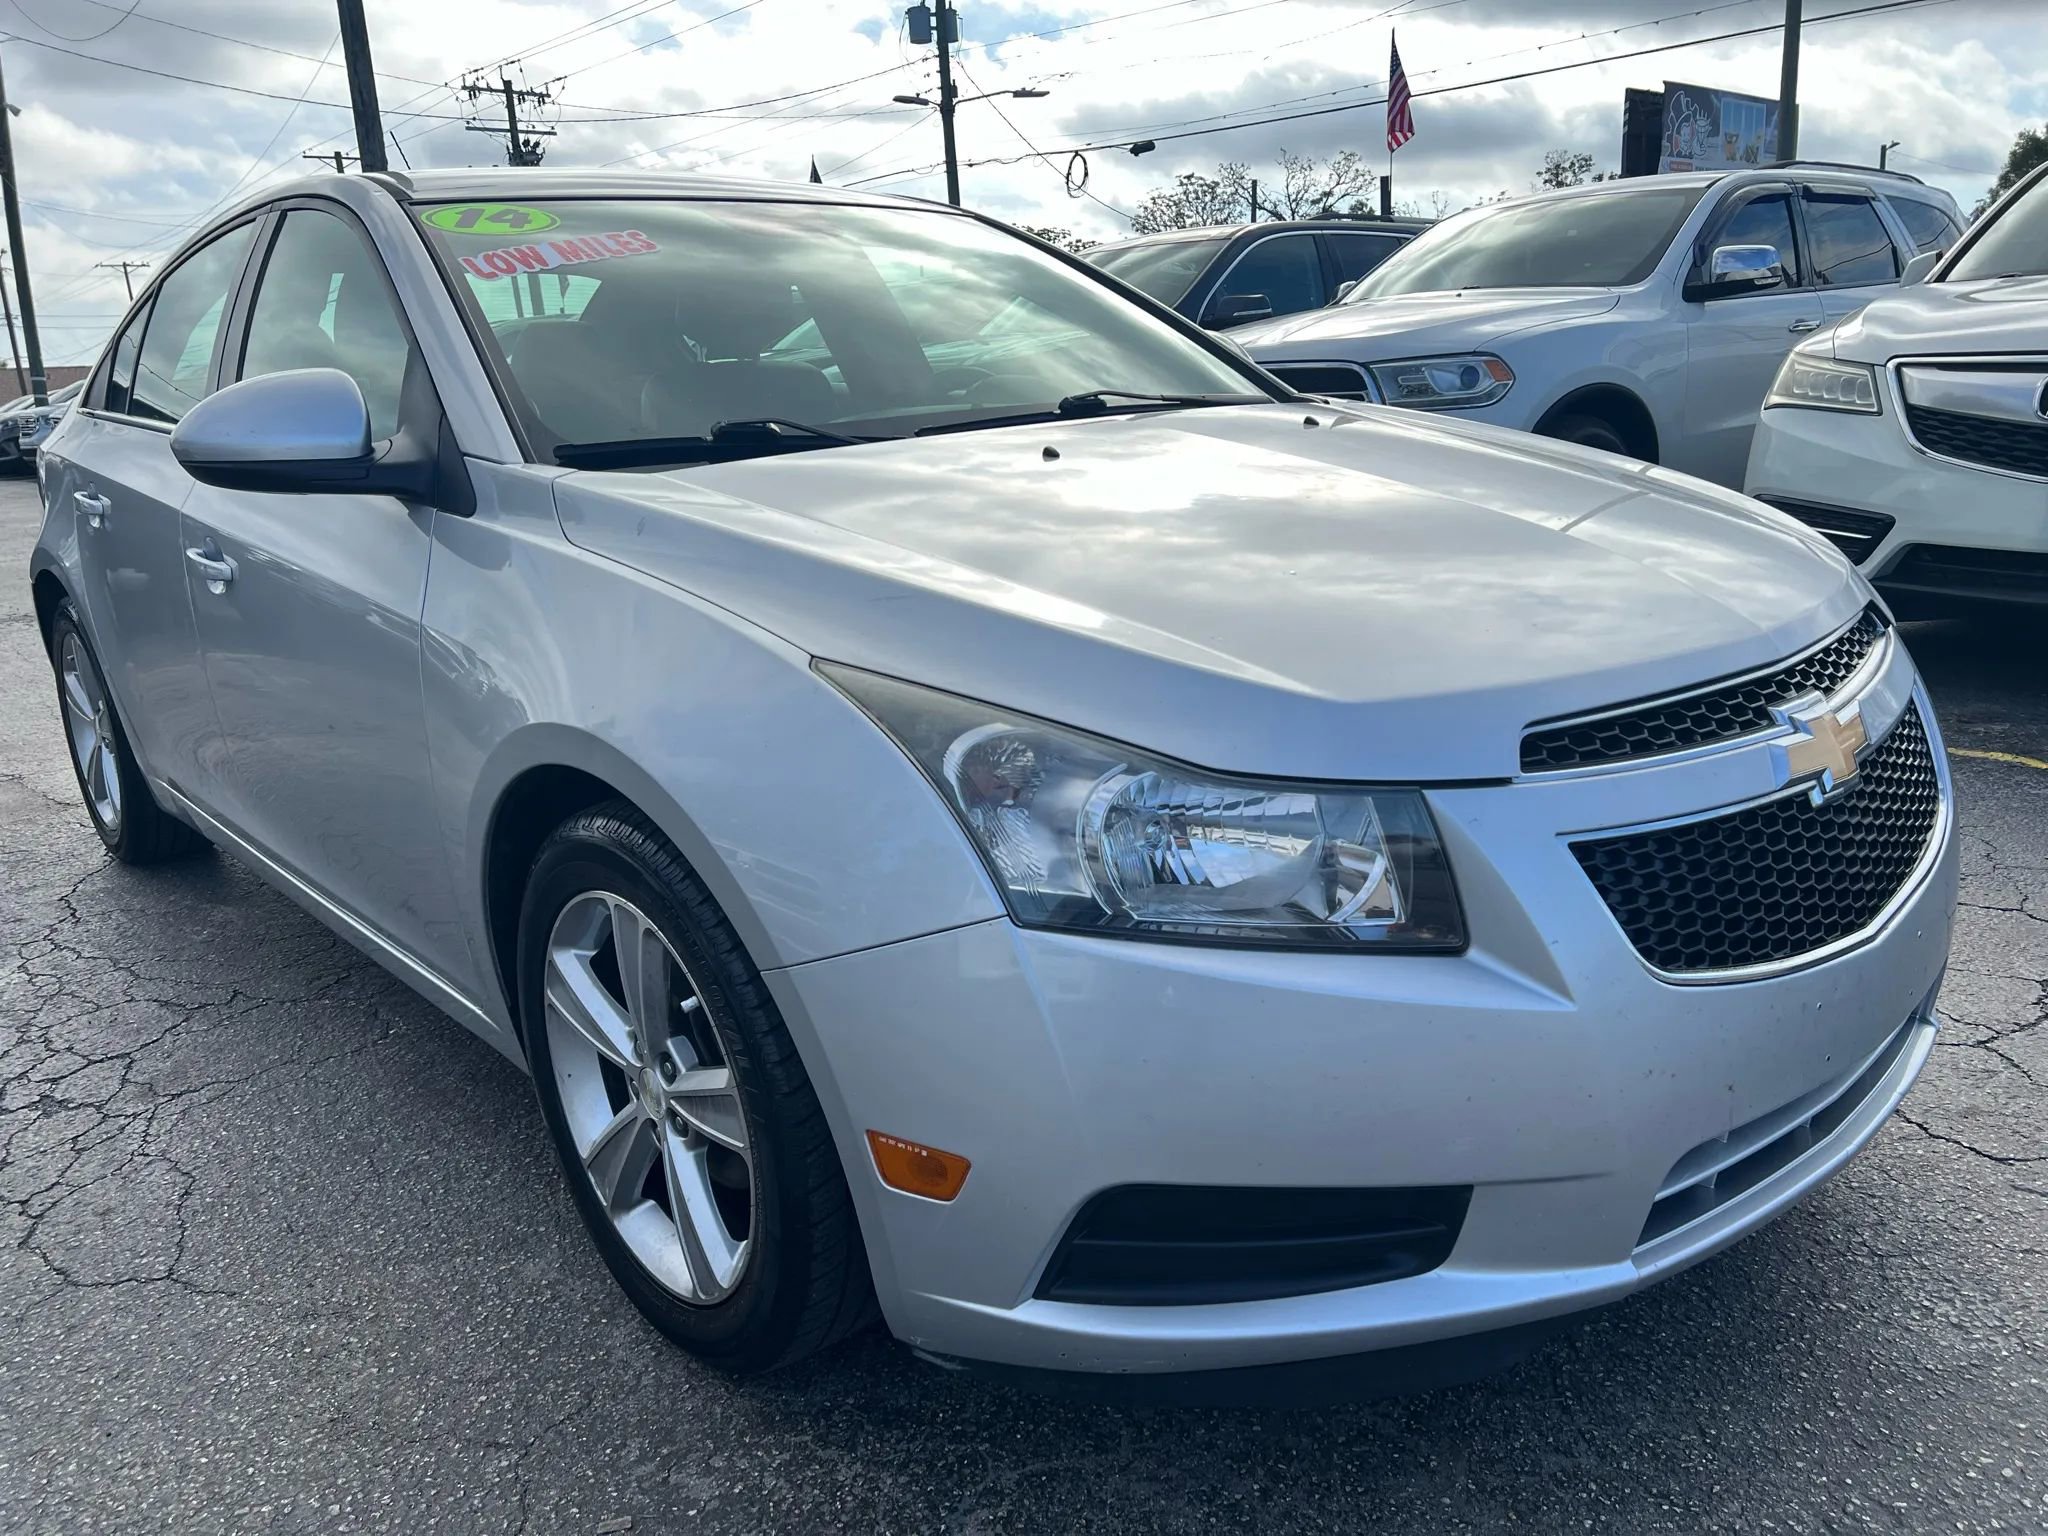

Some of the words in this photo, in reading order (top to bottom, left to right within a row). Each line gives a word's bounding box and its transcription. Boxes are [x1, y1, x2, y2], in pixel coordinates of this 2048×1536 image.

[454, 207, 532, 229] 14
[460, 244, 550, 280] LOW
[547, 230, 659, 265] MILES
